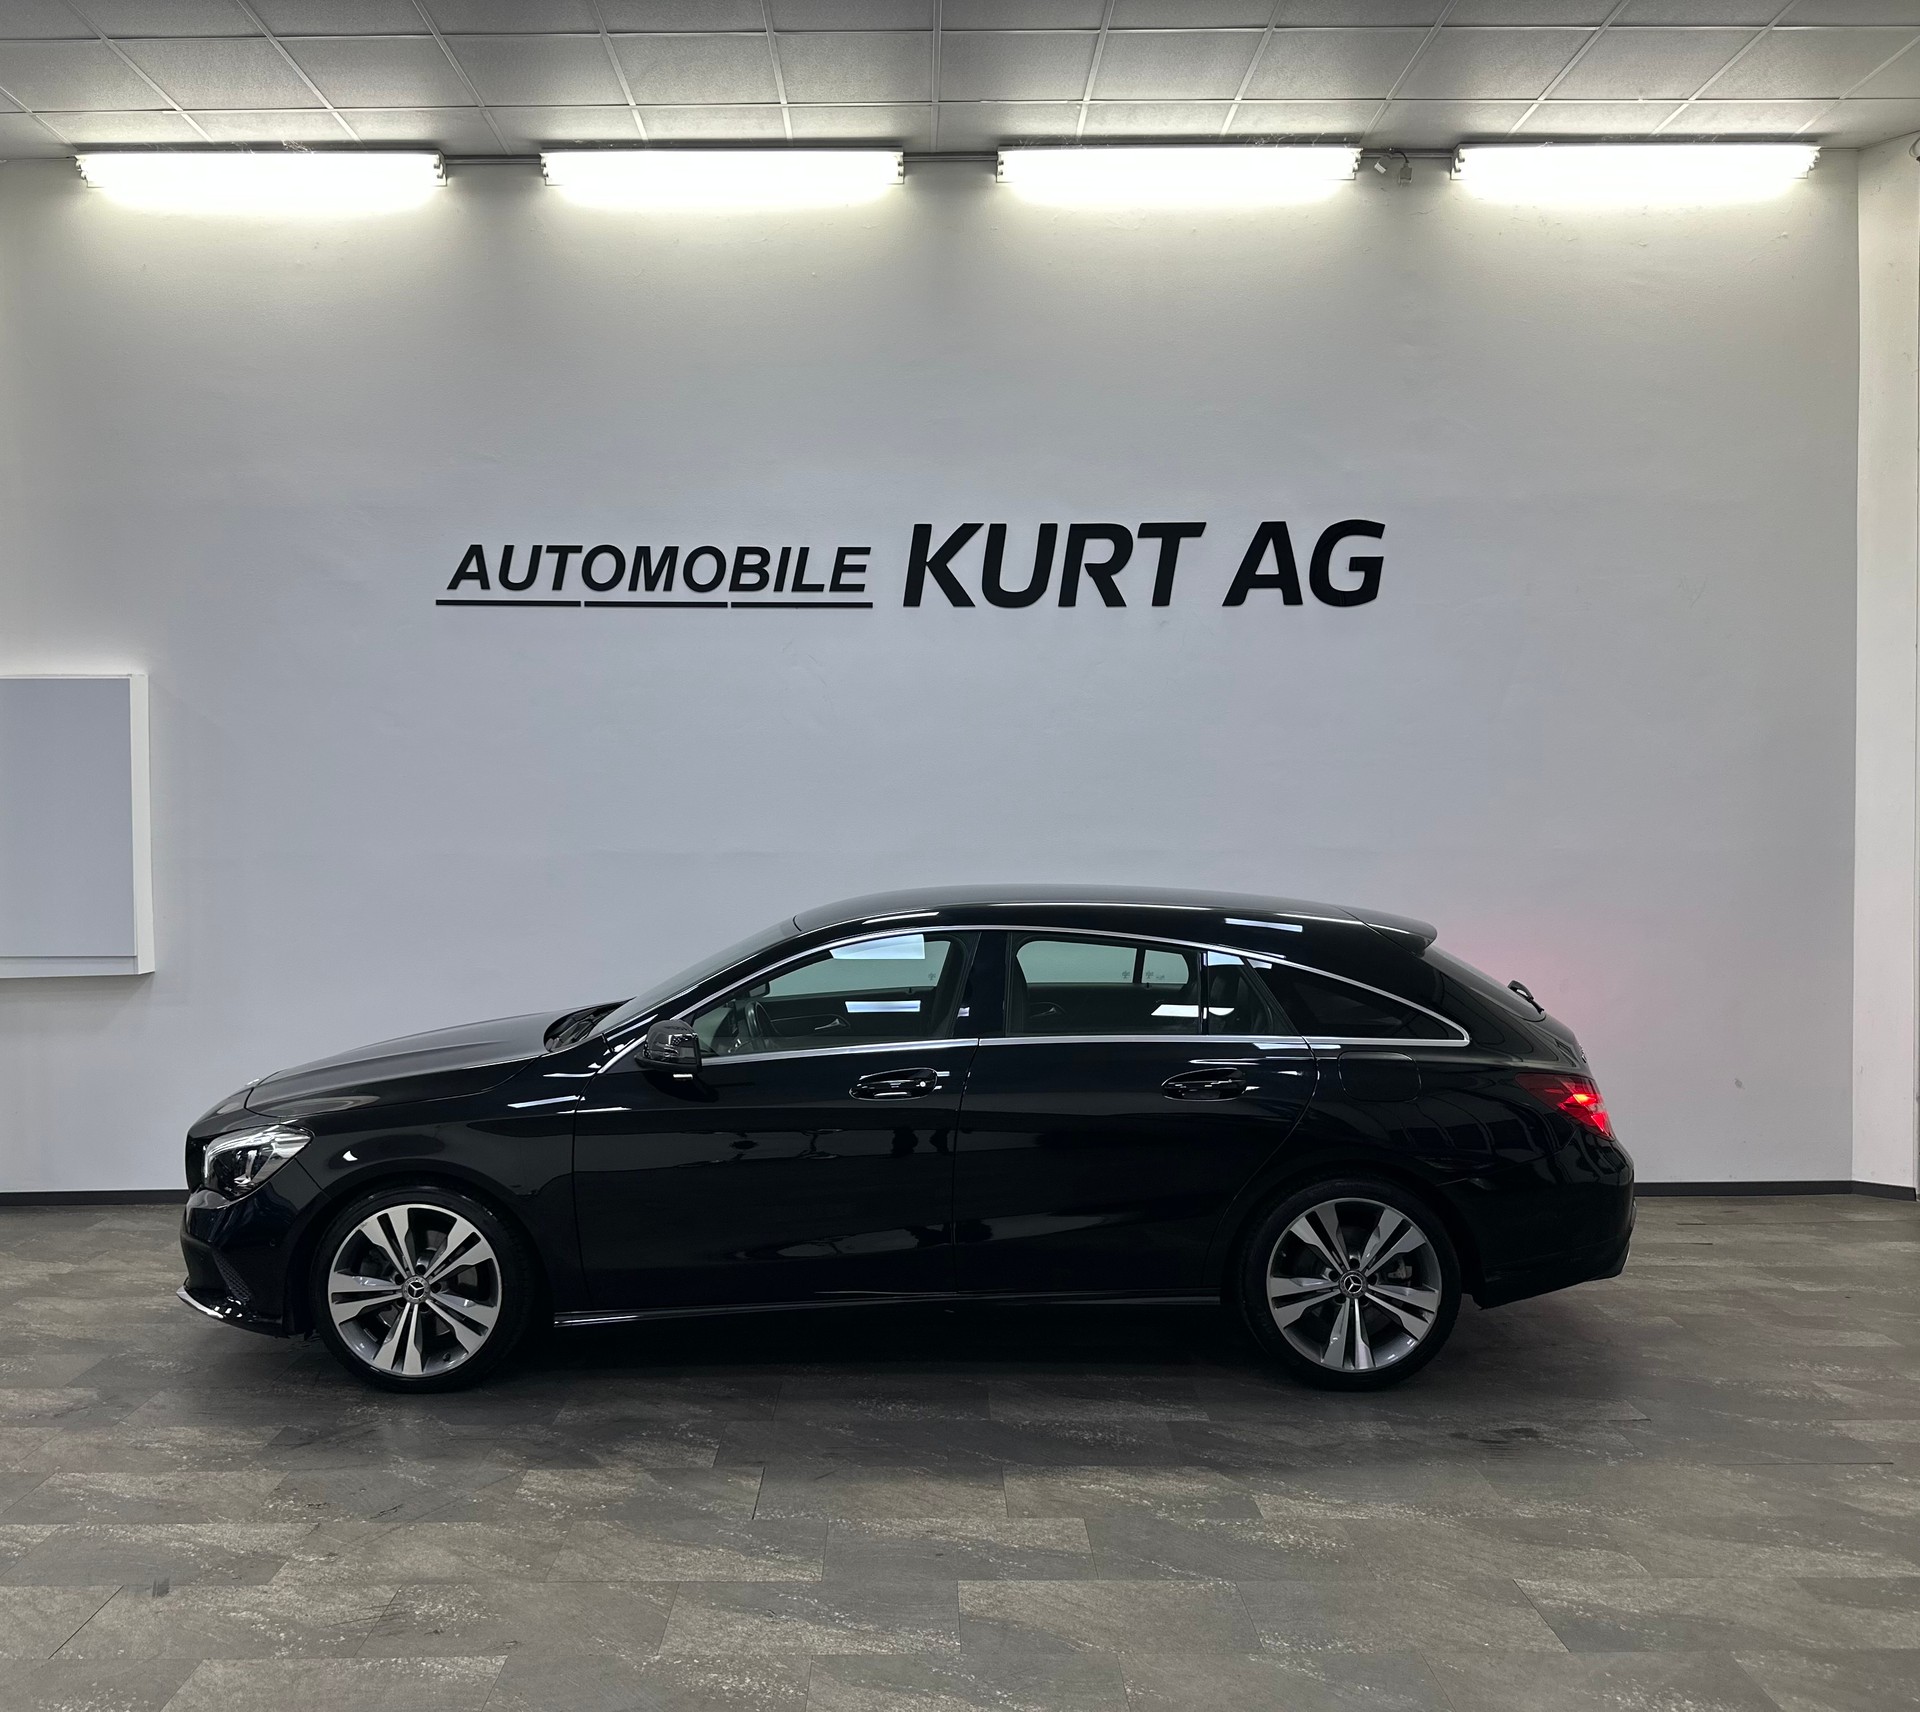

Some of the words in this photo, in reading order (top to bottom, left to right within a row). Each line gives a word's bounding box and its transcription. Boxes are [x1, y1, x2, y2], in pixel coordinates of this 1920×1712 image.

[447, 544, 872, 594] AUTOMOBILE
[902, 521, 1207, 609] KURT
[1221, 519, 1386, 608] AG
